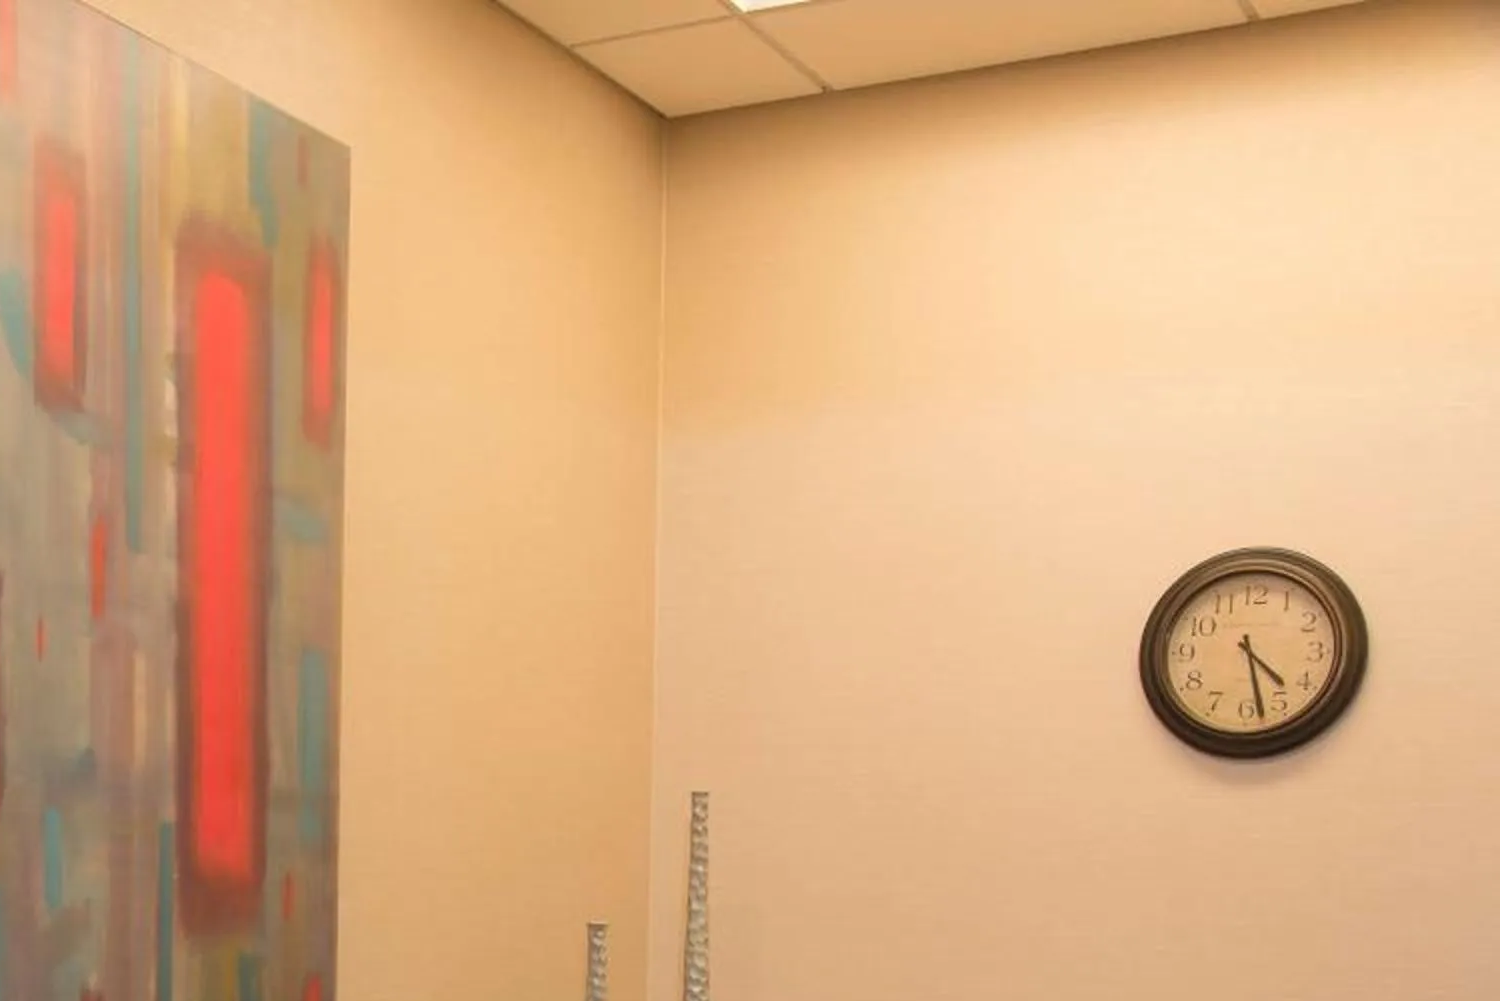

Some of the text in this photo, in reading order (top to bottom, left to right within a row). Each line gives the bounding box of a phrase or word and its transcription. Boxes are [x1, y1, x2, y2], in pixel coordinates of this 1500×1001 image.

[1215, 593, 1234, 614] 11
[1244, 585, 1268, 605] 12
[1283, 590, 1291, 612] 1
[1190, 616, 1217, 637] 10
[1300, 611, 1317, 633] 2
[1178, 643, 1195, 662] 9
[1306, 641, 1325, 663] 3
[1185, 671, 1204, 691] 8
[1296, 671, 1311, 691] 4
[1207, 690, 1224, 713] 7
[1237, 700, 1255, 720] 6
[1270, 691, 1288, 713] 5
